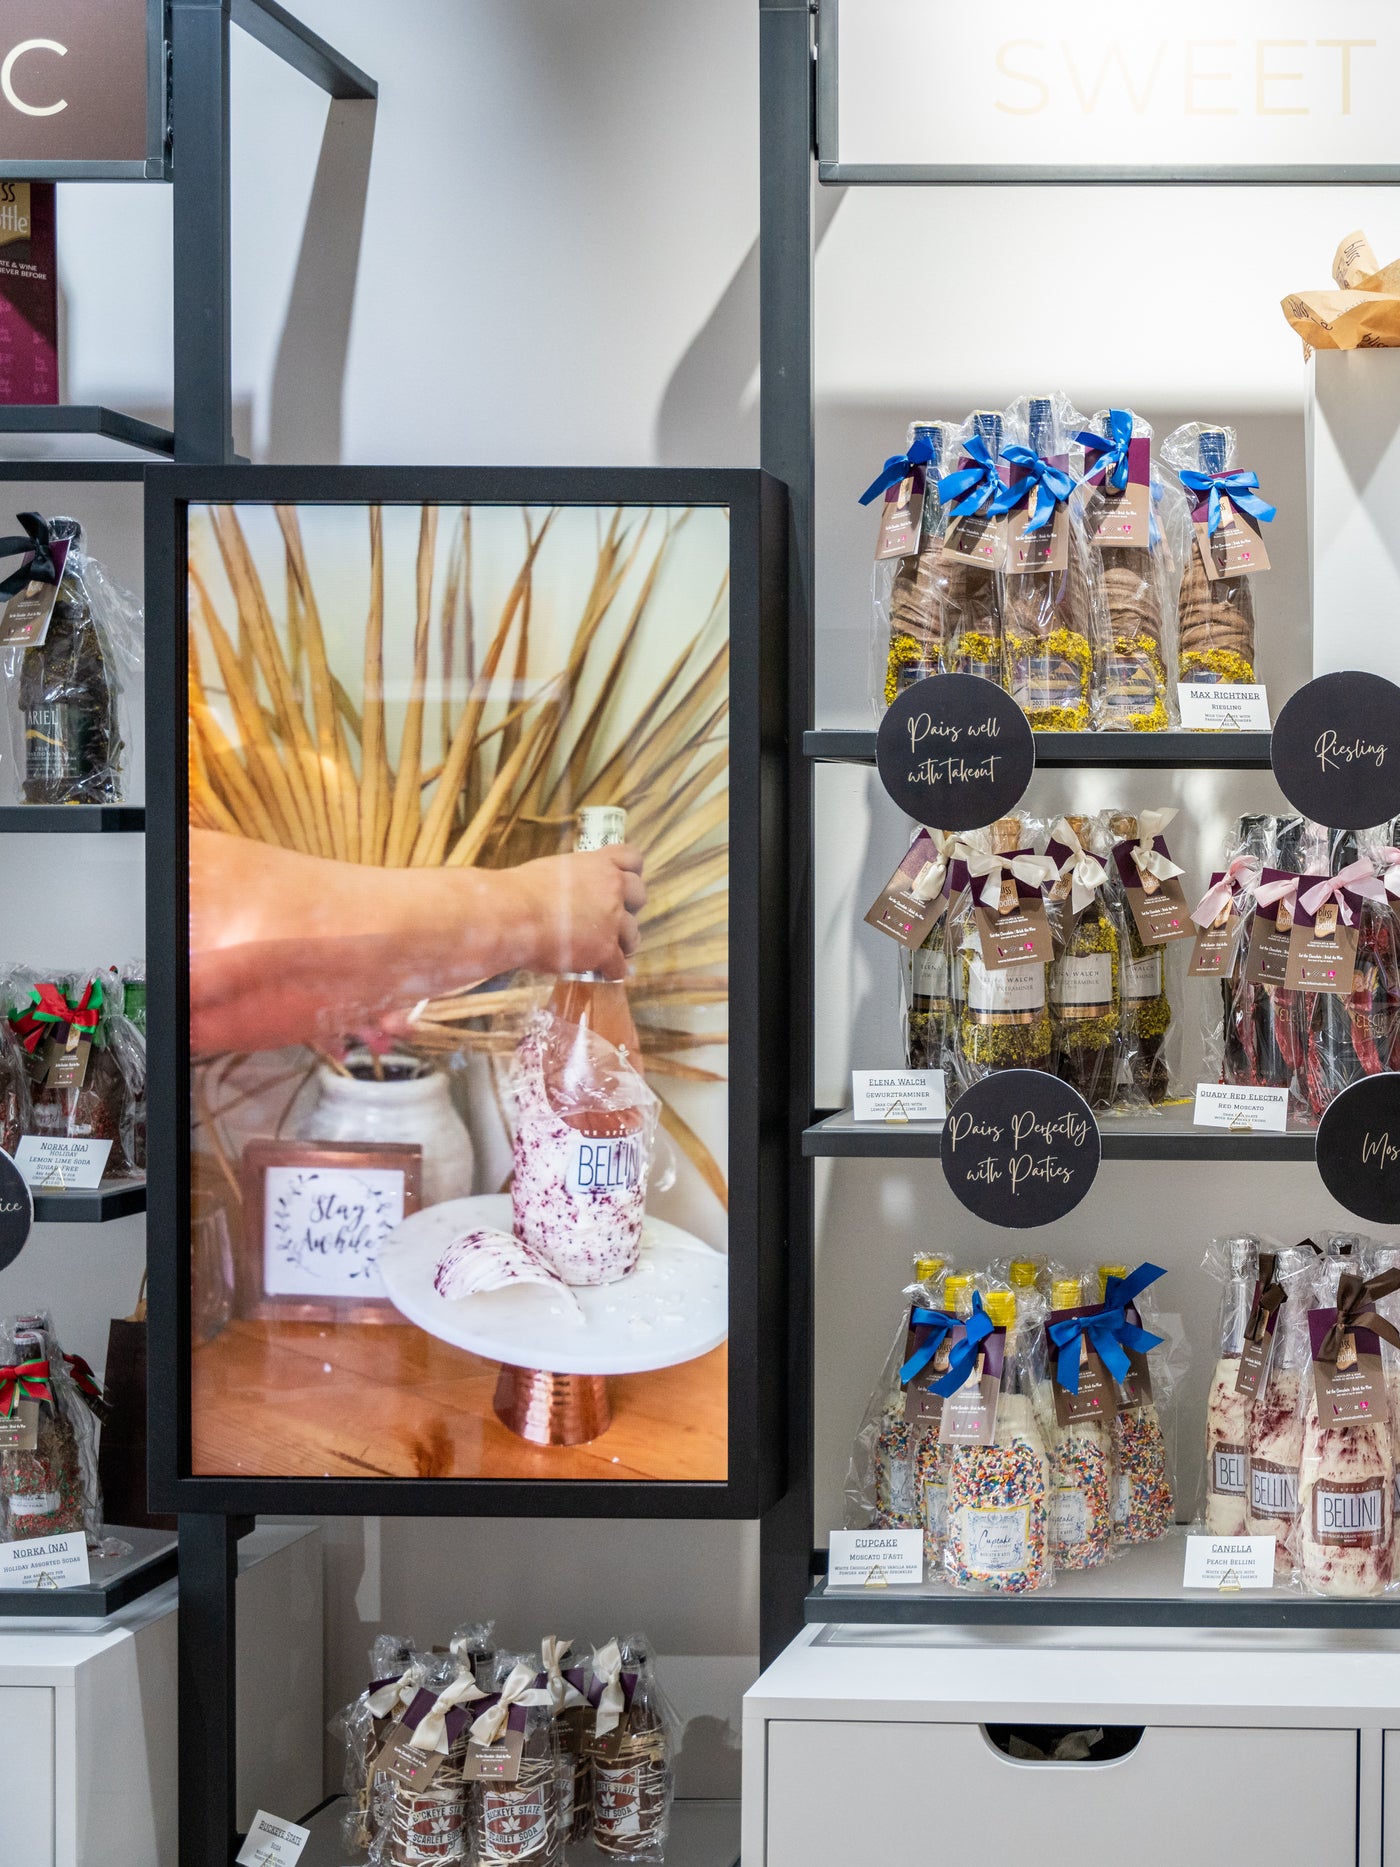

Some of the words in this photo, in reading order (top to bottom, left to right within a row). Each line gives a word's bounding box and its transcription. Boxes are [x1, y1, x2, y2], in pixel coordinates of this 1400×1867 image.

[994, 38, 1377, 116] SWEET
[0, 203, 28, 234] ttle
[19, 270, 47, 280] BEFORE
[1190, 691, 1212, 699] MAX
[1214, 691, 1260, 700] RICHTNER
[28, 710, 57, 725] ARIEL
[907, 713, 963, 754] Pairs
[967, 717, 1000, 737] well
[1314, 729, 1388, 772] Riesling
[907, 758, 942, 786] with
[939, 755, 1002, 785] takeout
[869, 1078, 897, 1086] ELENA
[897, 1078, 926, 1086] WALCH
[866, 1091, 930, 1099] GEWURZTRAMINER
[1200, 1090, 1227, 1098] QUADY
[1248, 1093, 1284, 1102] ELECTRA
[948, 1112, 1004, 1152] Pairs
[1011, 1110, 1092, 1151] Perfectly
[41, 1142, 68, 1152] NORKA
[966, 1156, 1002, 1184] with
[1008, 1154, 1075, 1194] Parties
[310, 1194, 365, 1231] Stay
[298, 1225, 374, 1255] Awhile
[1254, 1474, 1296, 1507] BELLIN
[1324, 1496, 1376, 1528] BELLINI
[13, 1546, 46, 1559] NORKA
[48, 1541, 69, 1554] (NA)
[855, 1538, 898, 1548] CUPCAKE
[1211, 1544, 1252, 1553] CANELLA
[3, 1564, 29, 1573] HOLIDAY
[30, 1559, 61, 1569] ASSORTED
[486, 1807, 516, 1821] BUCKEYE
[518, 1805, 541, 1815] STATE
[612, 1806, 632, 1818] SODA
[286, 1831, 302, 1846] STATE
[412, 1834, 444, 1844] SCARLET
[488, 1833, 516, 1843] SCARLET
[518, 1827, 538, 1841] SODA
